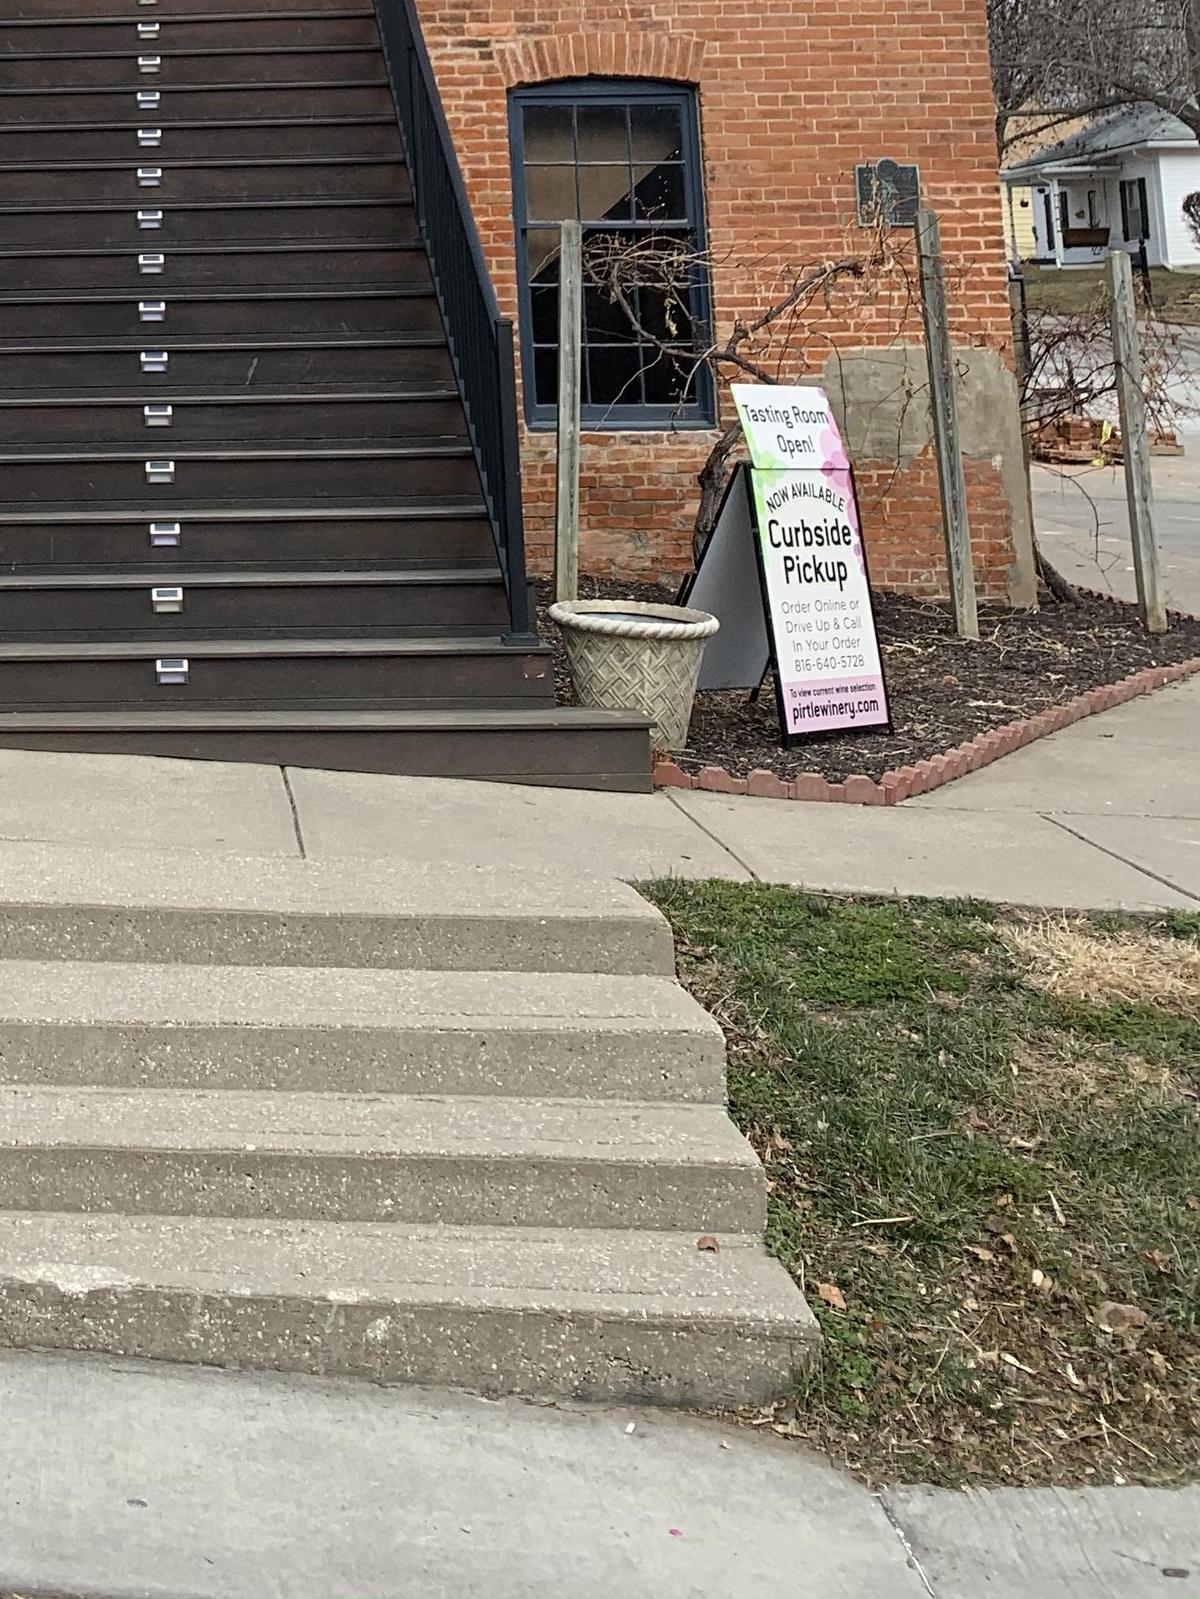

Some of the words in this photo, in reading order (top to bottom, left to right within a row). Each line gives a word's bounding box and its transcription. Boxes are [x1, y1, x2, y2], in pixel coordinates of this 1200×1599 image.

[742, 403, 793, 430] Tasting
[794, 405, 829, 426] Room
[776, 433, 816, 459] Open!
[766, 486, 791, 514] NOW
[791, 482, 846, 513] AVAILABLE
[768, 517, 853, 549] Curbside
[784, 555, 848, 592] Pickup
[781, 601, 811, 614] Order
[814, 599, 847, 613] Online
[849, 600, 860, 611] or
[785, 620, 813, 634] Drive
[815, 619, 831, 633] Up
[833, 617, 840, 631] &
[843, 616, 862, 630] Call
[793, 640, 803, 653] In
[805, 639, 829, 652] Your
[832, 636, 861, 650] Order
[794, 654, 865, 672] 816-640-5728
[790, 688, 797, 698] To
[798, 688, 812, 697] view
[813, 686, 834, 697] current
[835, 684, 849, 694] wine
[850, 682, 876, 693] selection
[792, 698, 879, 725] pirtlewinery.com
